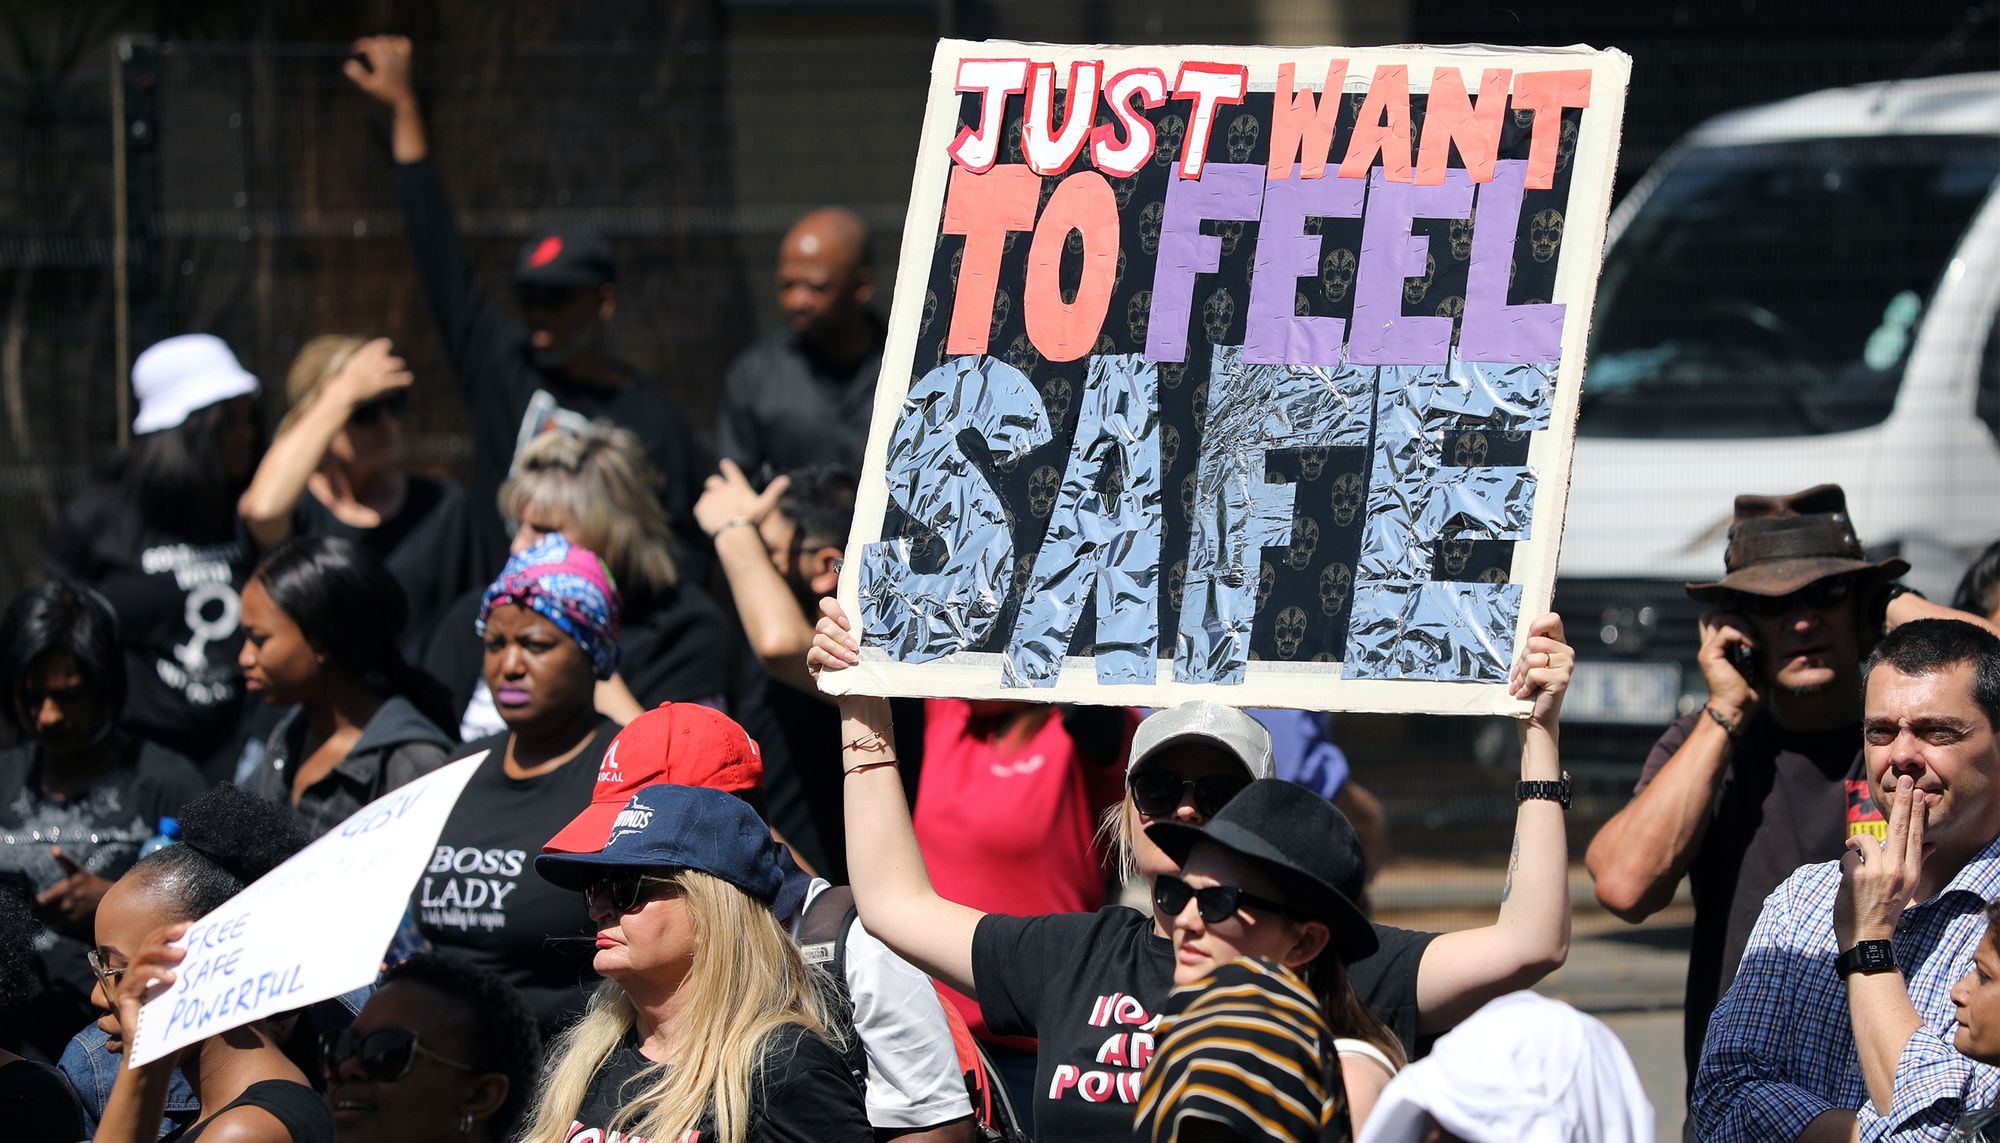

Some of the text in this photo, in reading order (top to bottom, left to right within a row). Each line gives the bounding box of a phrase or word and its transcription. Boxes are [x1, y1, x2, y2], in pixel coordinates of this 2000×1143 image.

[947, 57, 1592, 189] JUST WANT
[942, 158, 1567, 366] TO FEEL
[859, 344, 1563, 689] SAFE
[428, 845, 527, 877] BOSS
[420, 877, 517, 909] LADY
[185, 912, 251, 952] FREE
[179, 948, 244, 994] SAFE
[163, 964, 305, 1041] POWERFUL
